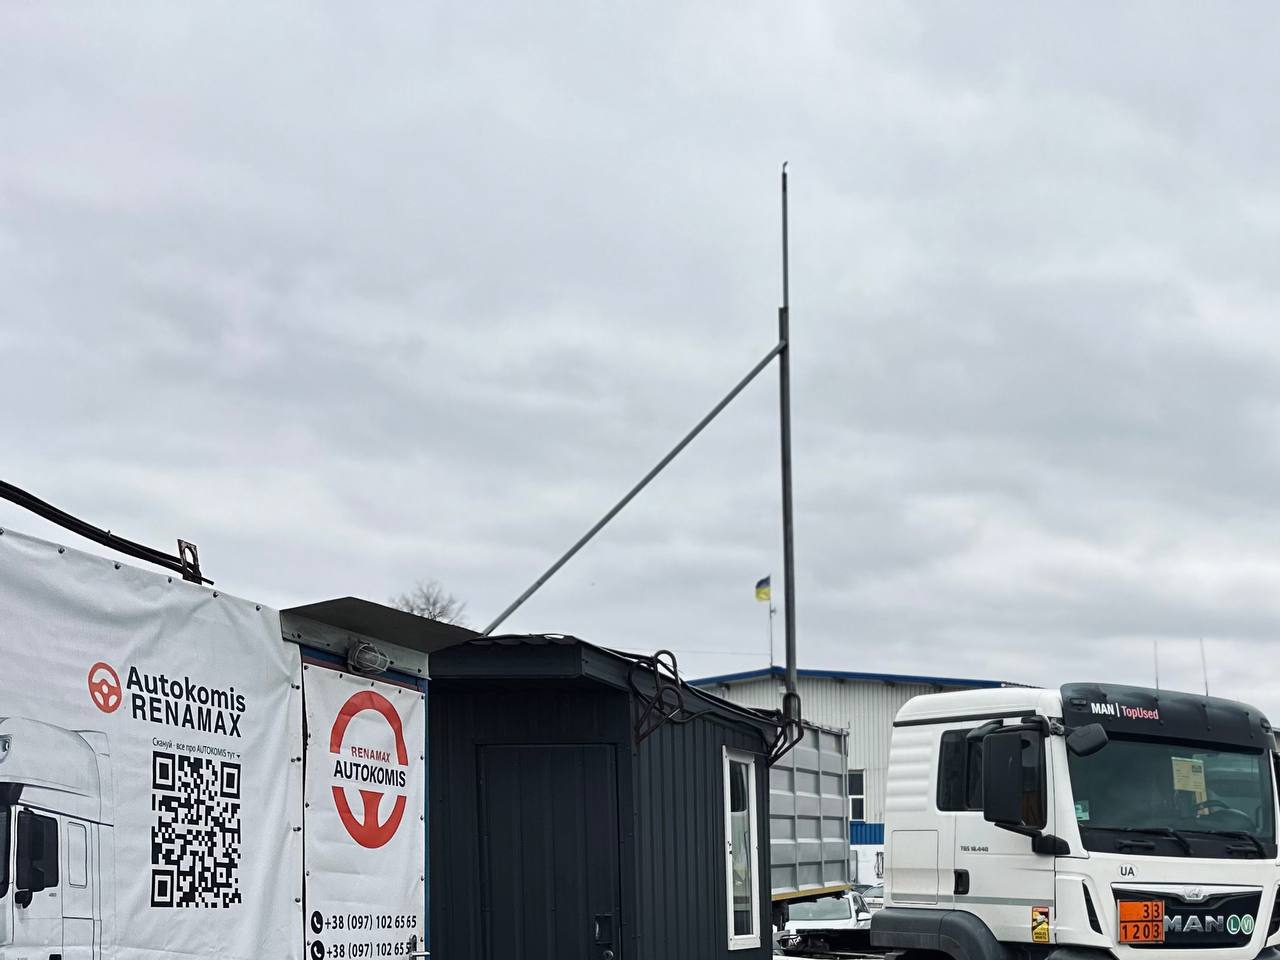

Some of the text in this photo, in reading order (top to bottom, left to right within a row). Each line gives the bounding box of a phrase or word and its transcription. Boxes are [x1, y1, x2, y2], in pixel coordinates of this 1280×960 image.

[127, 666, 246, 713] Autokomis
[132, 693, 242, 738] RENAMAX
[1090, 702, 1159, 719] MAN TopUsed
[197, 744, 227, 758] AUTOKOMIS
[351, 746, 391, 763] RENAMAX
[334, 760, 406, 788] AUTOKOMIS
[1120, 866, 1135, 877] UA
[1143, 903, 1160, 919] 33
[325, 915, 344, 930] +38
[347, 914, 373, 931] (097)
[376, 915, 392, 929] 102
[1122, 922, 1160, 940] 1203
[1165, 915, 1225, 933] MAN
[326, 943, 345, 959] +38
[348, 942, 373, 959] (097)
[376, 943, 392, 956] 102
